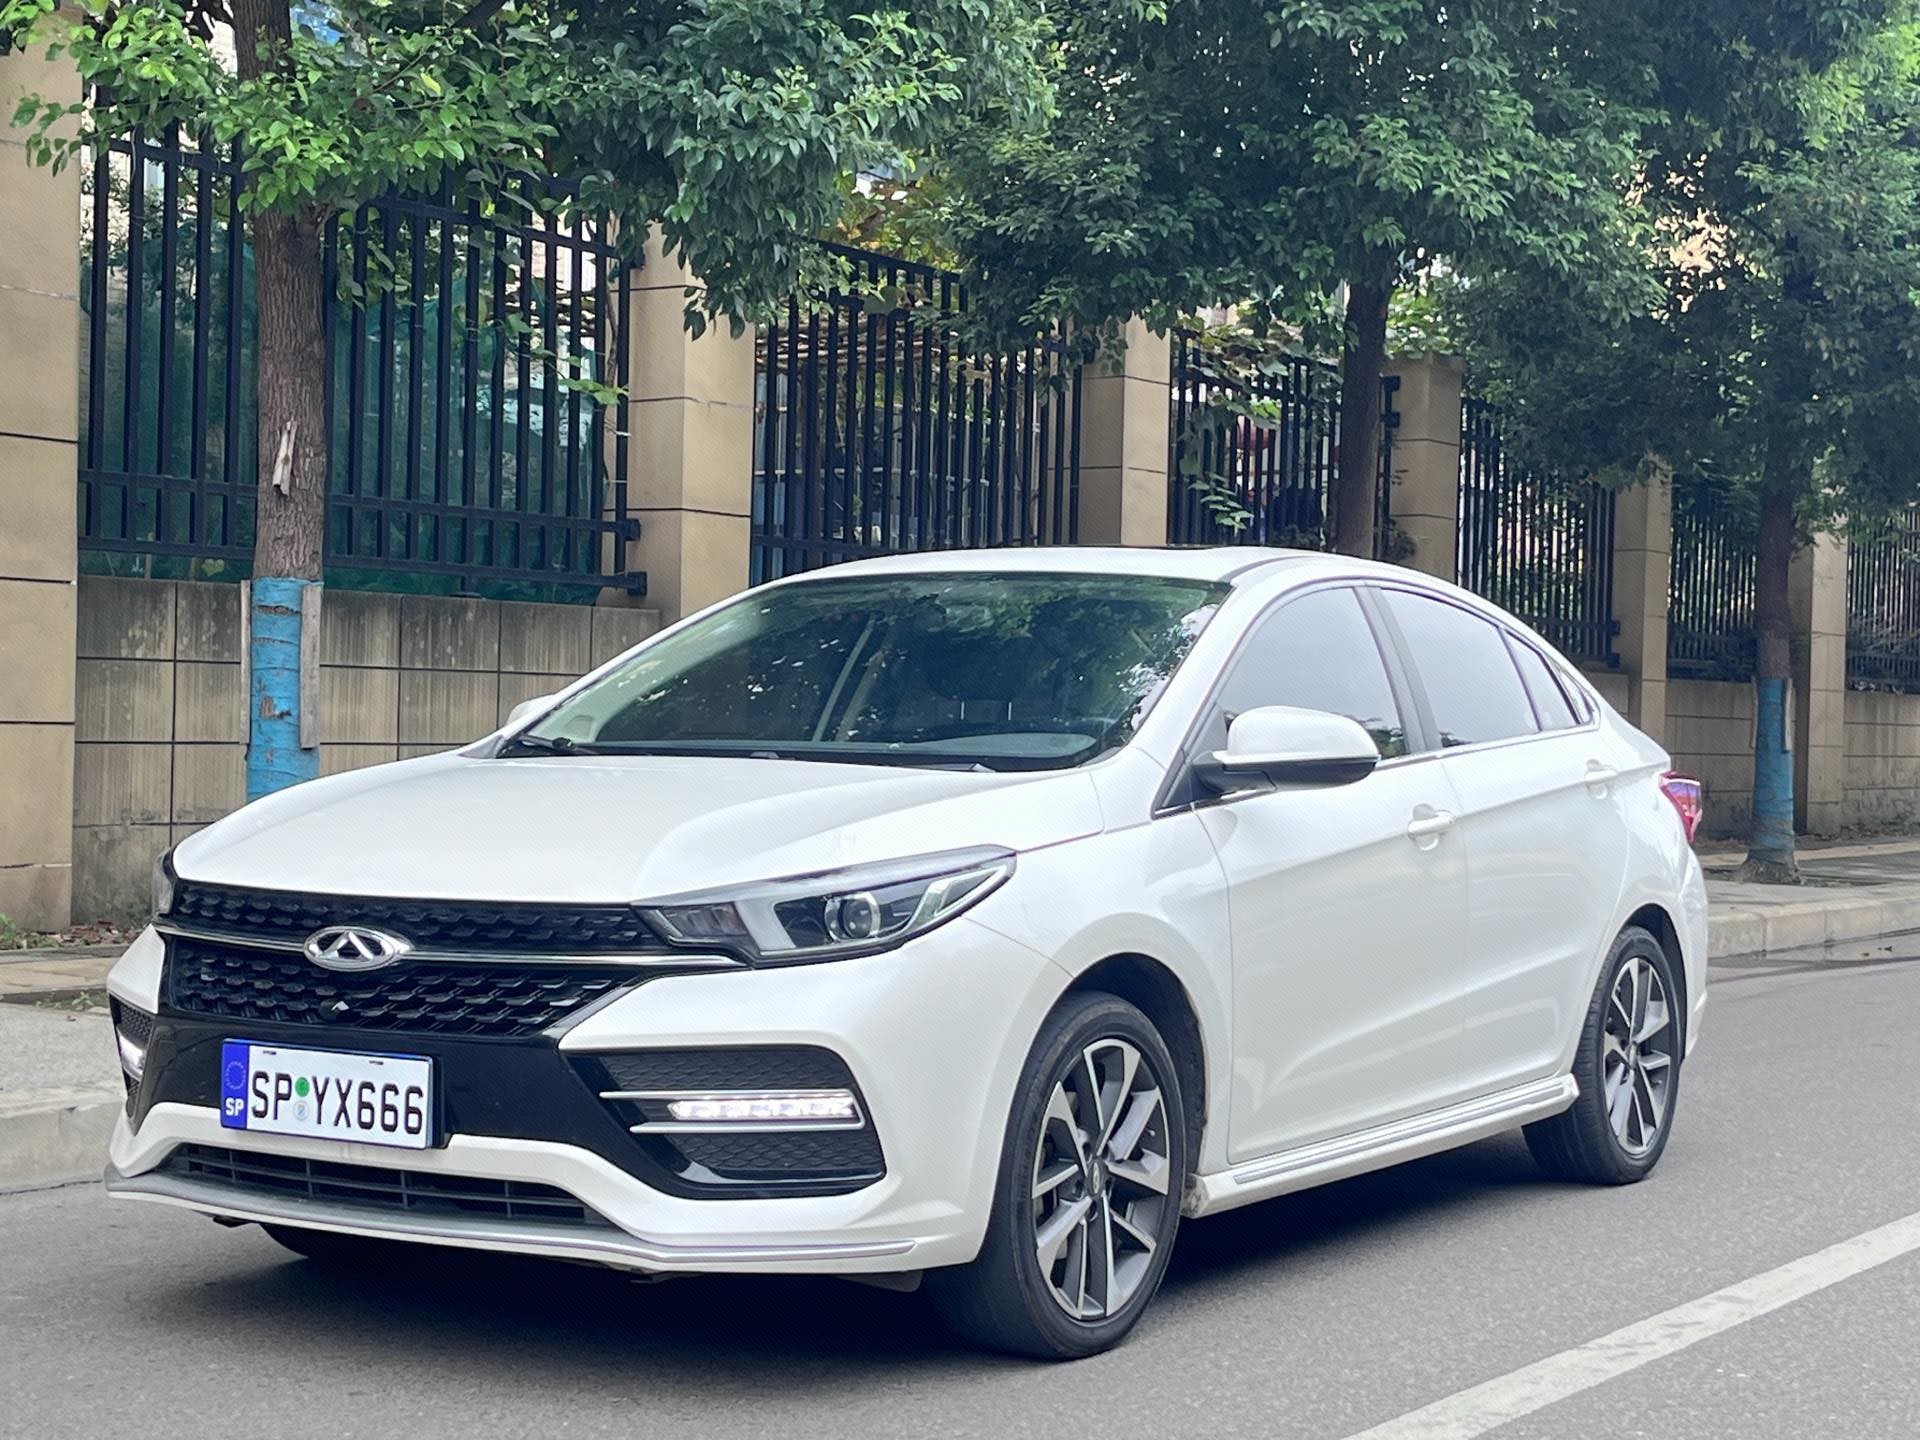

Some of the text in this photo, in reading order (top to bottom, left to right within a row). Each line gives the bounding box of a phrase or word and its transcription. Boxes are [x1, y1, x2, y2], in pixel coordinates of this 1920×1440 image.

[225, 1098, 244, 1116] SP
[252, 1071, 423, 1135] SP YX666
